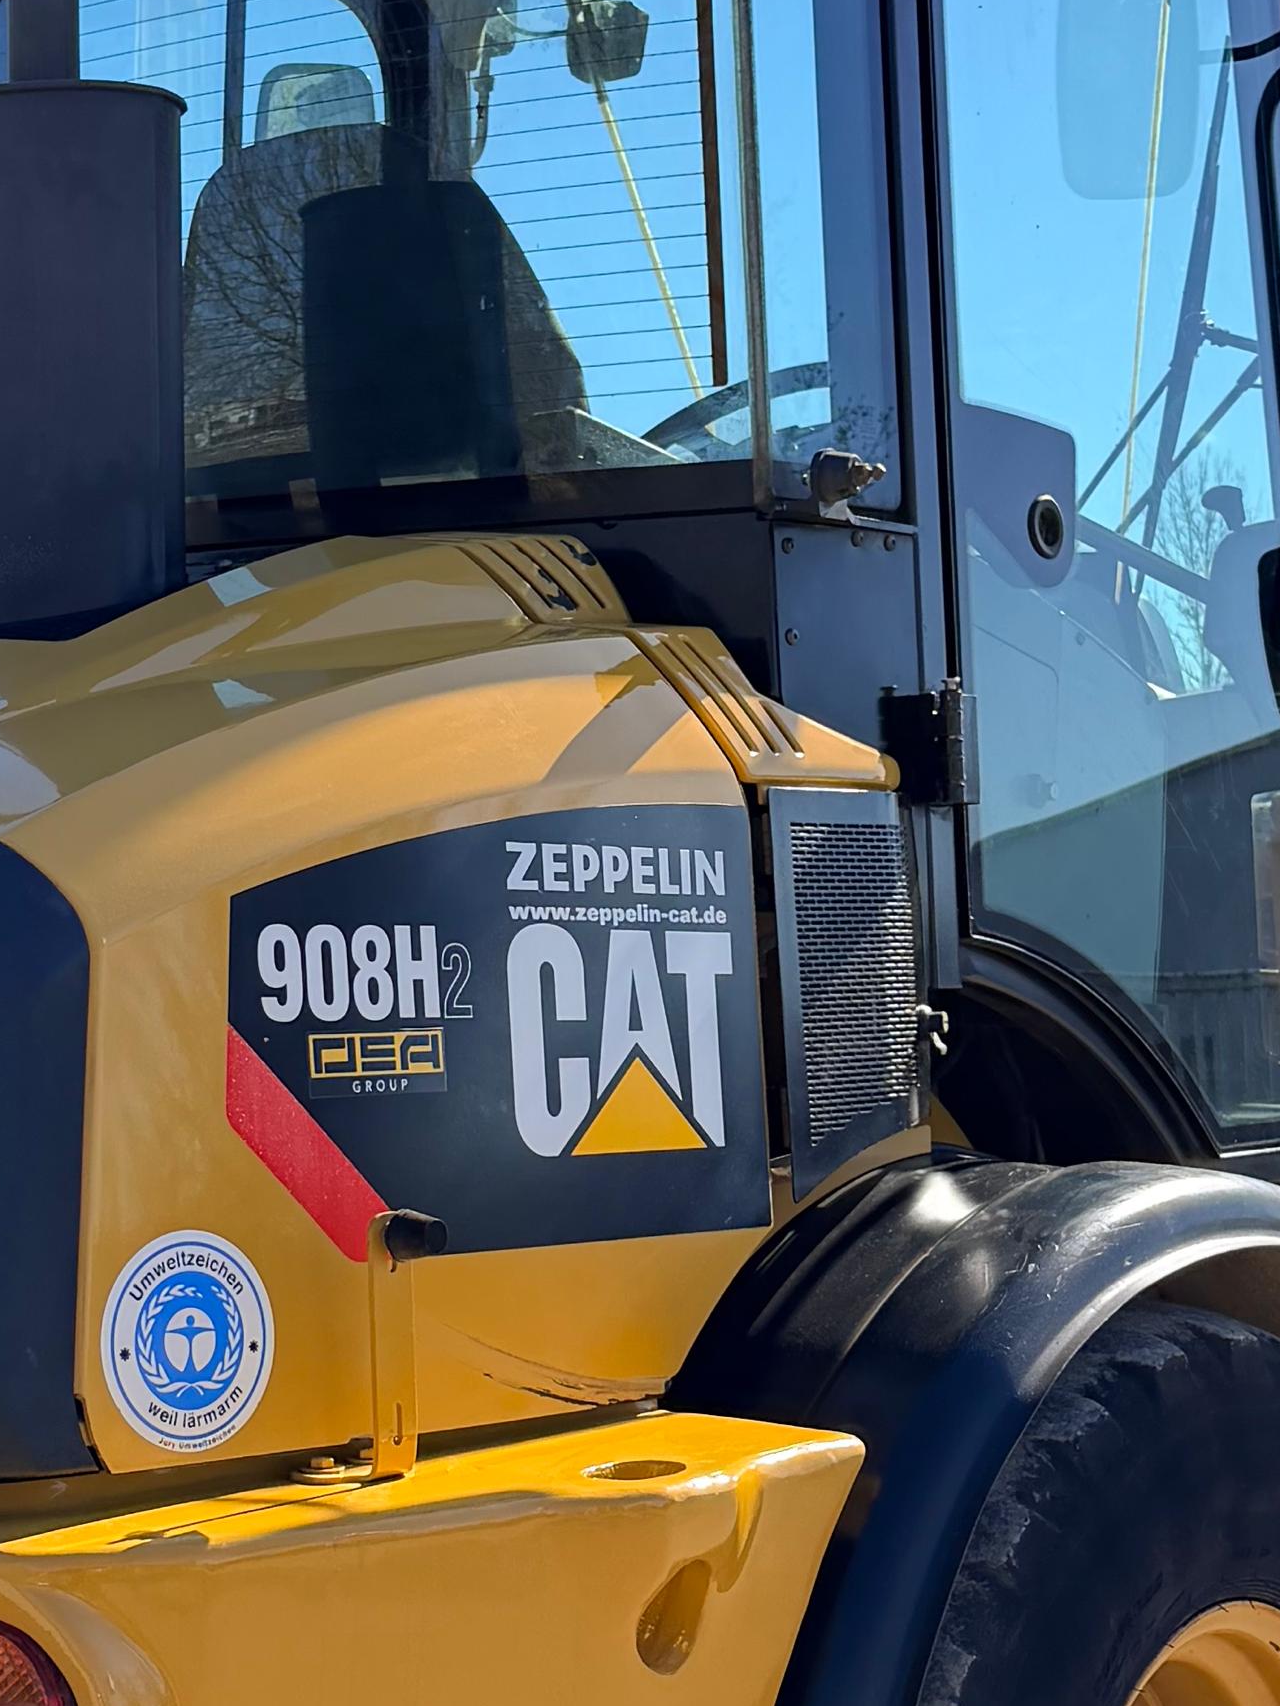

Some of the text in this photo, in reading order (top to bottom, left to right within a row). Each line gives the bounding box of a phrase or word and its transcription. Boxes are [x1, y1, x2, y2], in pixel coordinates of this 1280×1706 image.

[505, 840, 726, 896] ZEPPELIN
[508, 904, 728, 927] www.zeppelin-cat.de
[506, 923, 734, 1158] CAT
[352, 1078, 409, 1093] GROUP
[128, 1250, 244, 1302] Umweltzeichen
[147, 1385, 243, 1429] weil lärmarm
